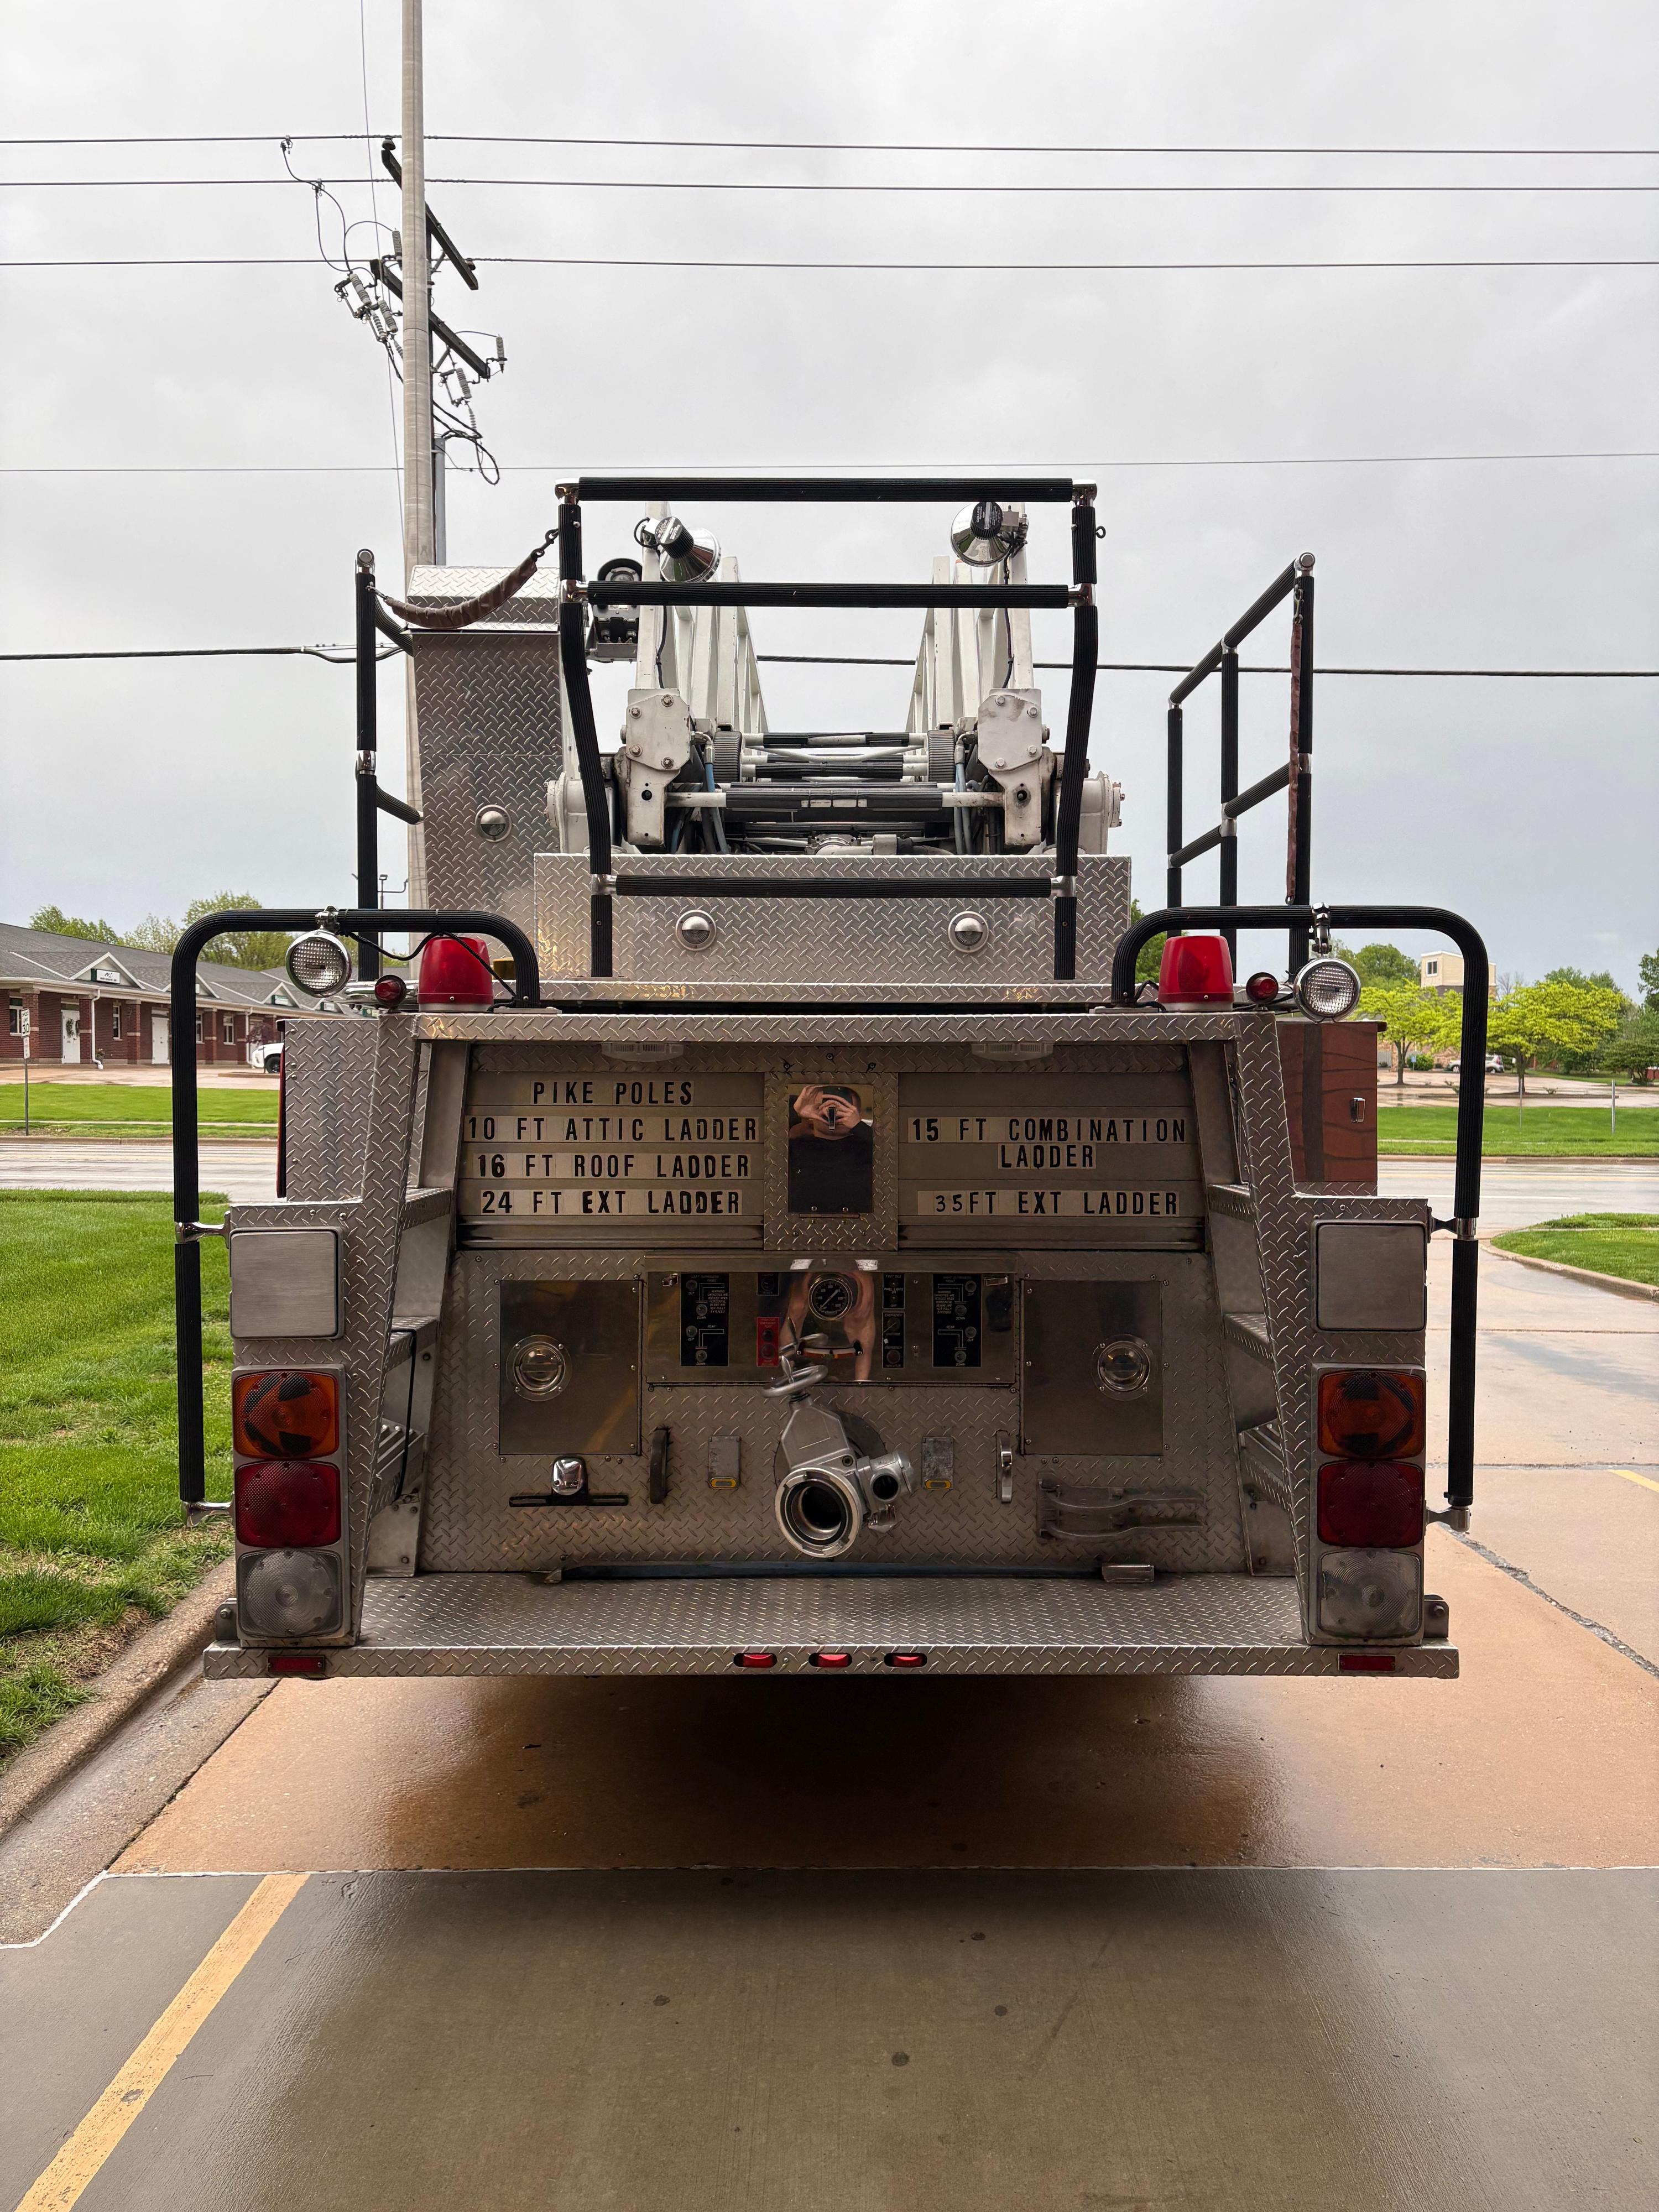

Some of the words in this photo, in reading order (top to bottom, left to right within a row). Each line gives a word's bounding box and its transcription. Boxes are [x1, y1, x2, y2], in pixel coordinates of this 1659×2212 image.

[22, 1023, 29, 1034] 30
[533, 1081, 594, 1104] PIKE
[615, 1081, 692, 1105] POLES
[468, 1117, 495, 1140] 10
[517, 1117, 545, 1141] FT
[565, 1118, 644, 1141] ATTIC
[665, 1118, 757, 1141] LADDER
[912, 1118, 939, 1141] 15
[959, 1118, 987, 1141] FT
[1009, 1118, 1185, 1142] COMBINATION
[477, 1154, 505, 1178] 16
[525, 1154, 553, 1177] FT
[574, 1154, 635, 1178] ROOF
[657, 1155, 748, 1178] LADDER
[482, 1191, 513, 1214] 24
[533, 1191, 562, 1214] FT
[582, 1191, 626, 1214] EXT
[648, 1190, 739, 1214] LADDER
[1018, 1191, 1061, 1214] EXT
[1083, 1192, 1177, 1215] LADDER
